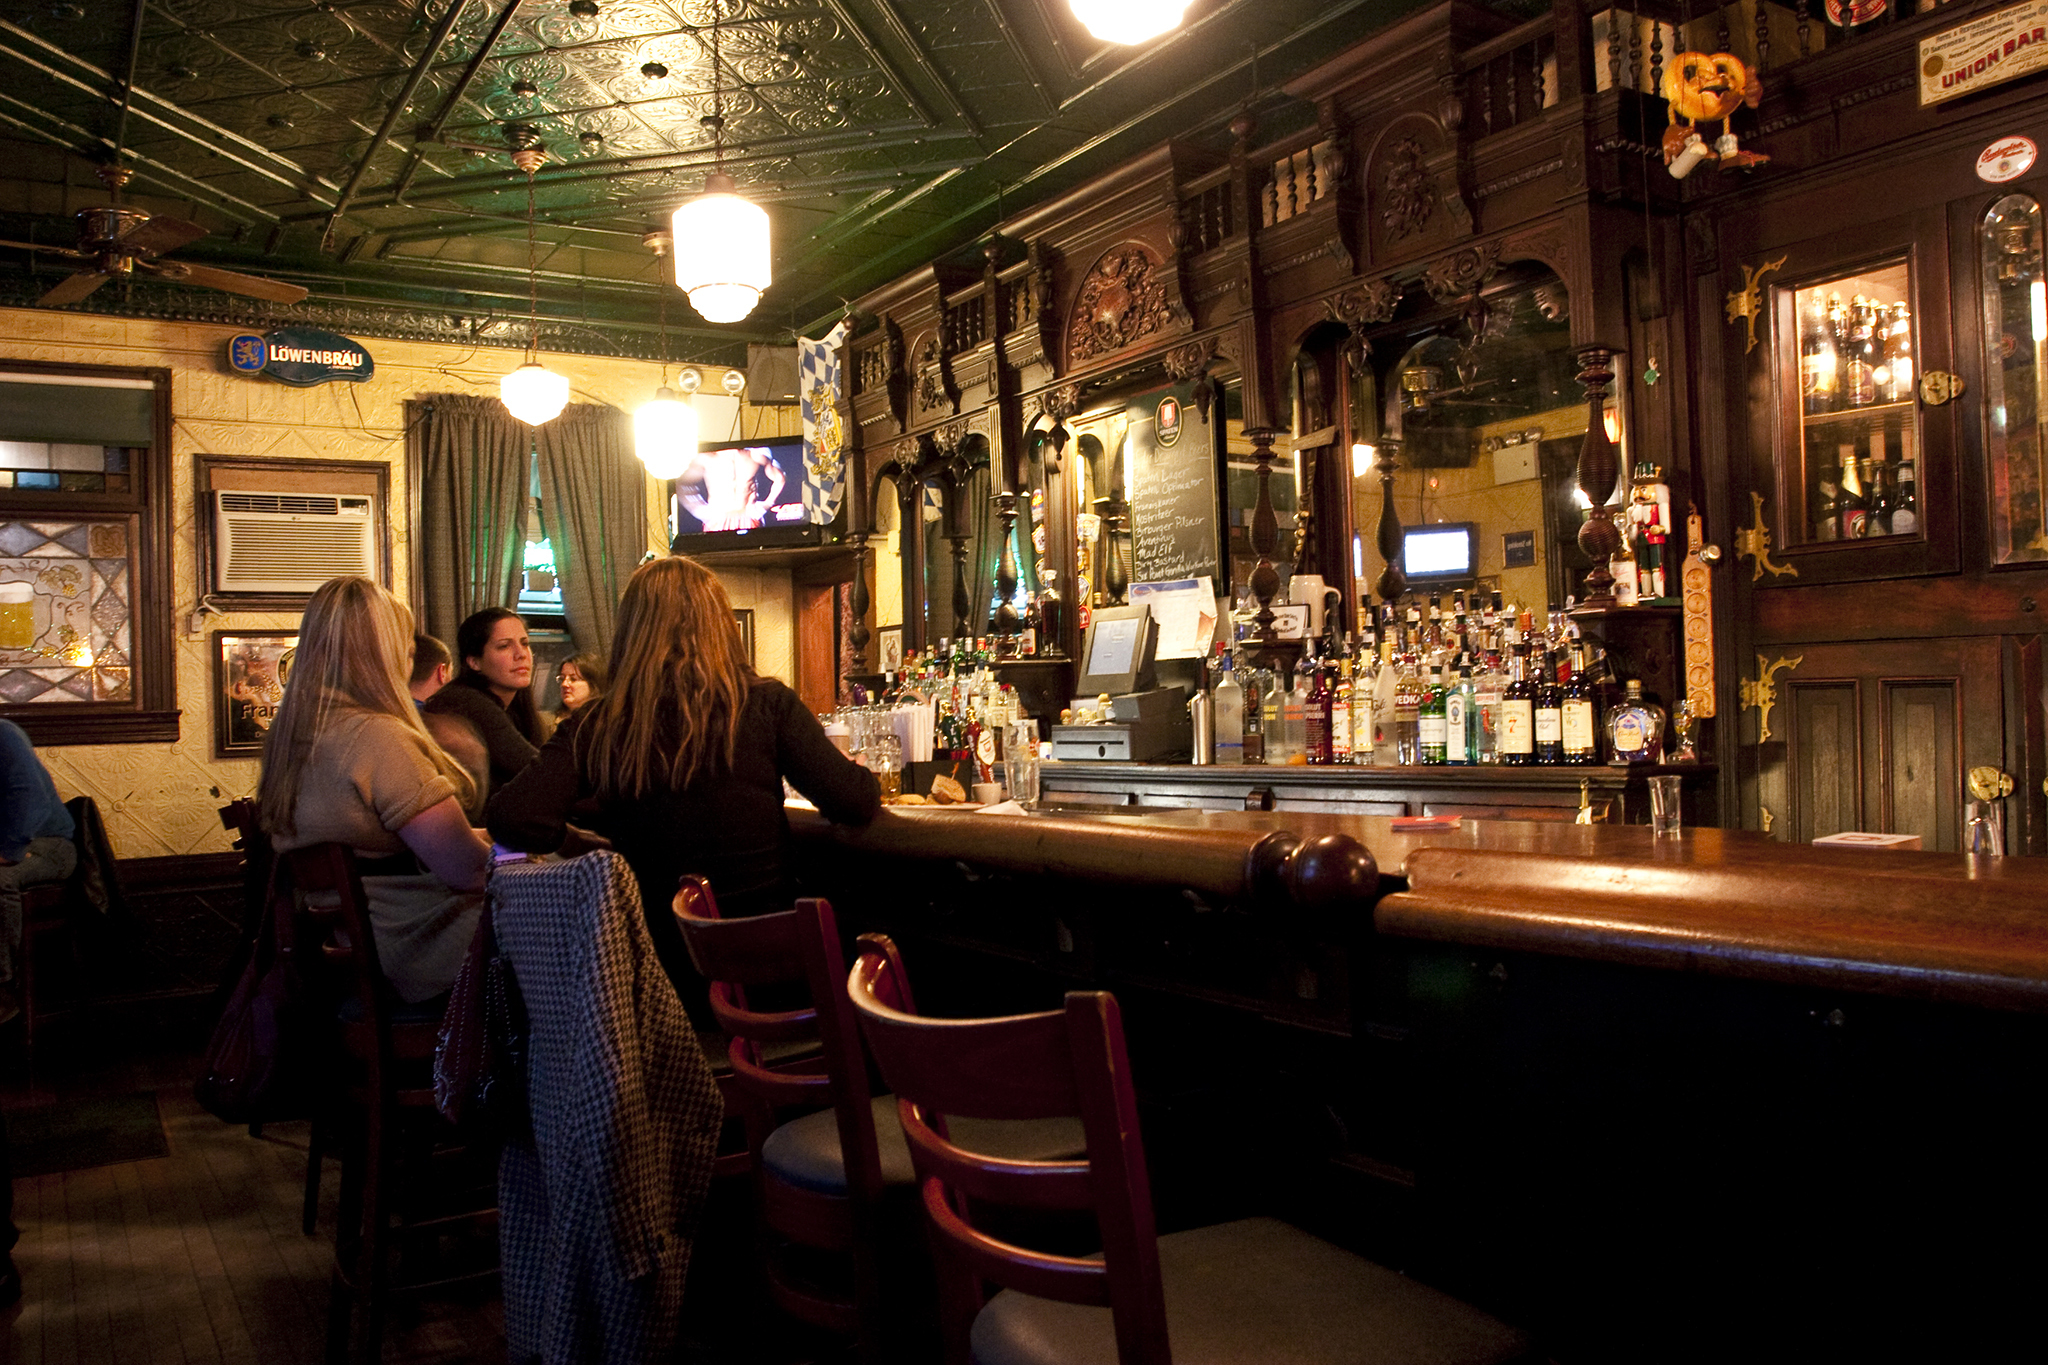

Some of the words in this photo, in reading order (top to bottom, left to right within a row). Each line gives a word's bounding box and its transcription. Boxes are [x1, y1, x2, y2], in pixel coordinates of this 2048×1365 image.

[1941, 48, 2000, 89] UNION
[2003, 27, 2046, 57] BAR
[269, 344, 363, 367] LÖWENBRÄU
[1161, 467, 1190, 483] Lager
[1174, 515, 1205, 530] Pilsner
[1137, 545, 1157, 560] Mad
[1158, 541, 1175, 557] Elf
[1395, 694, 1420, 705] VEDKA
[1508, 719, 1517, 733] 7
